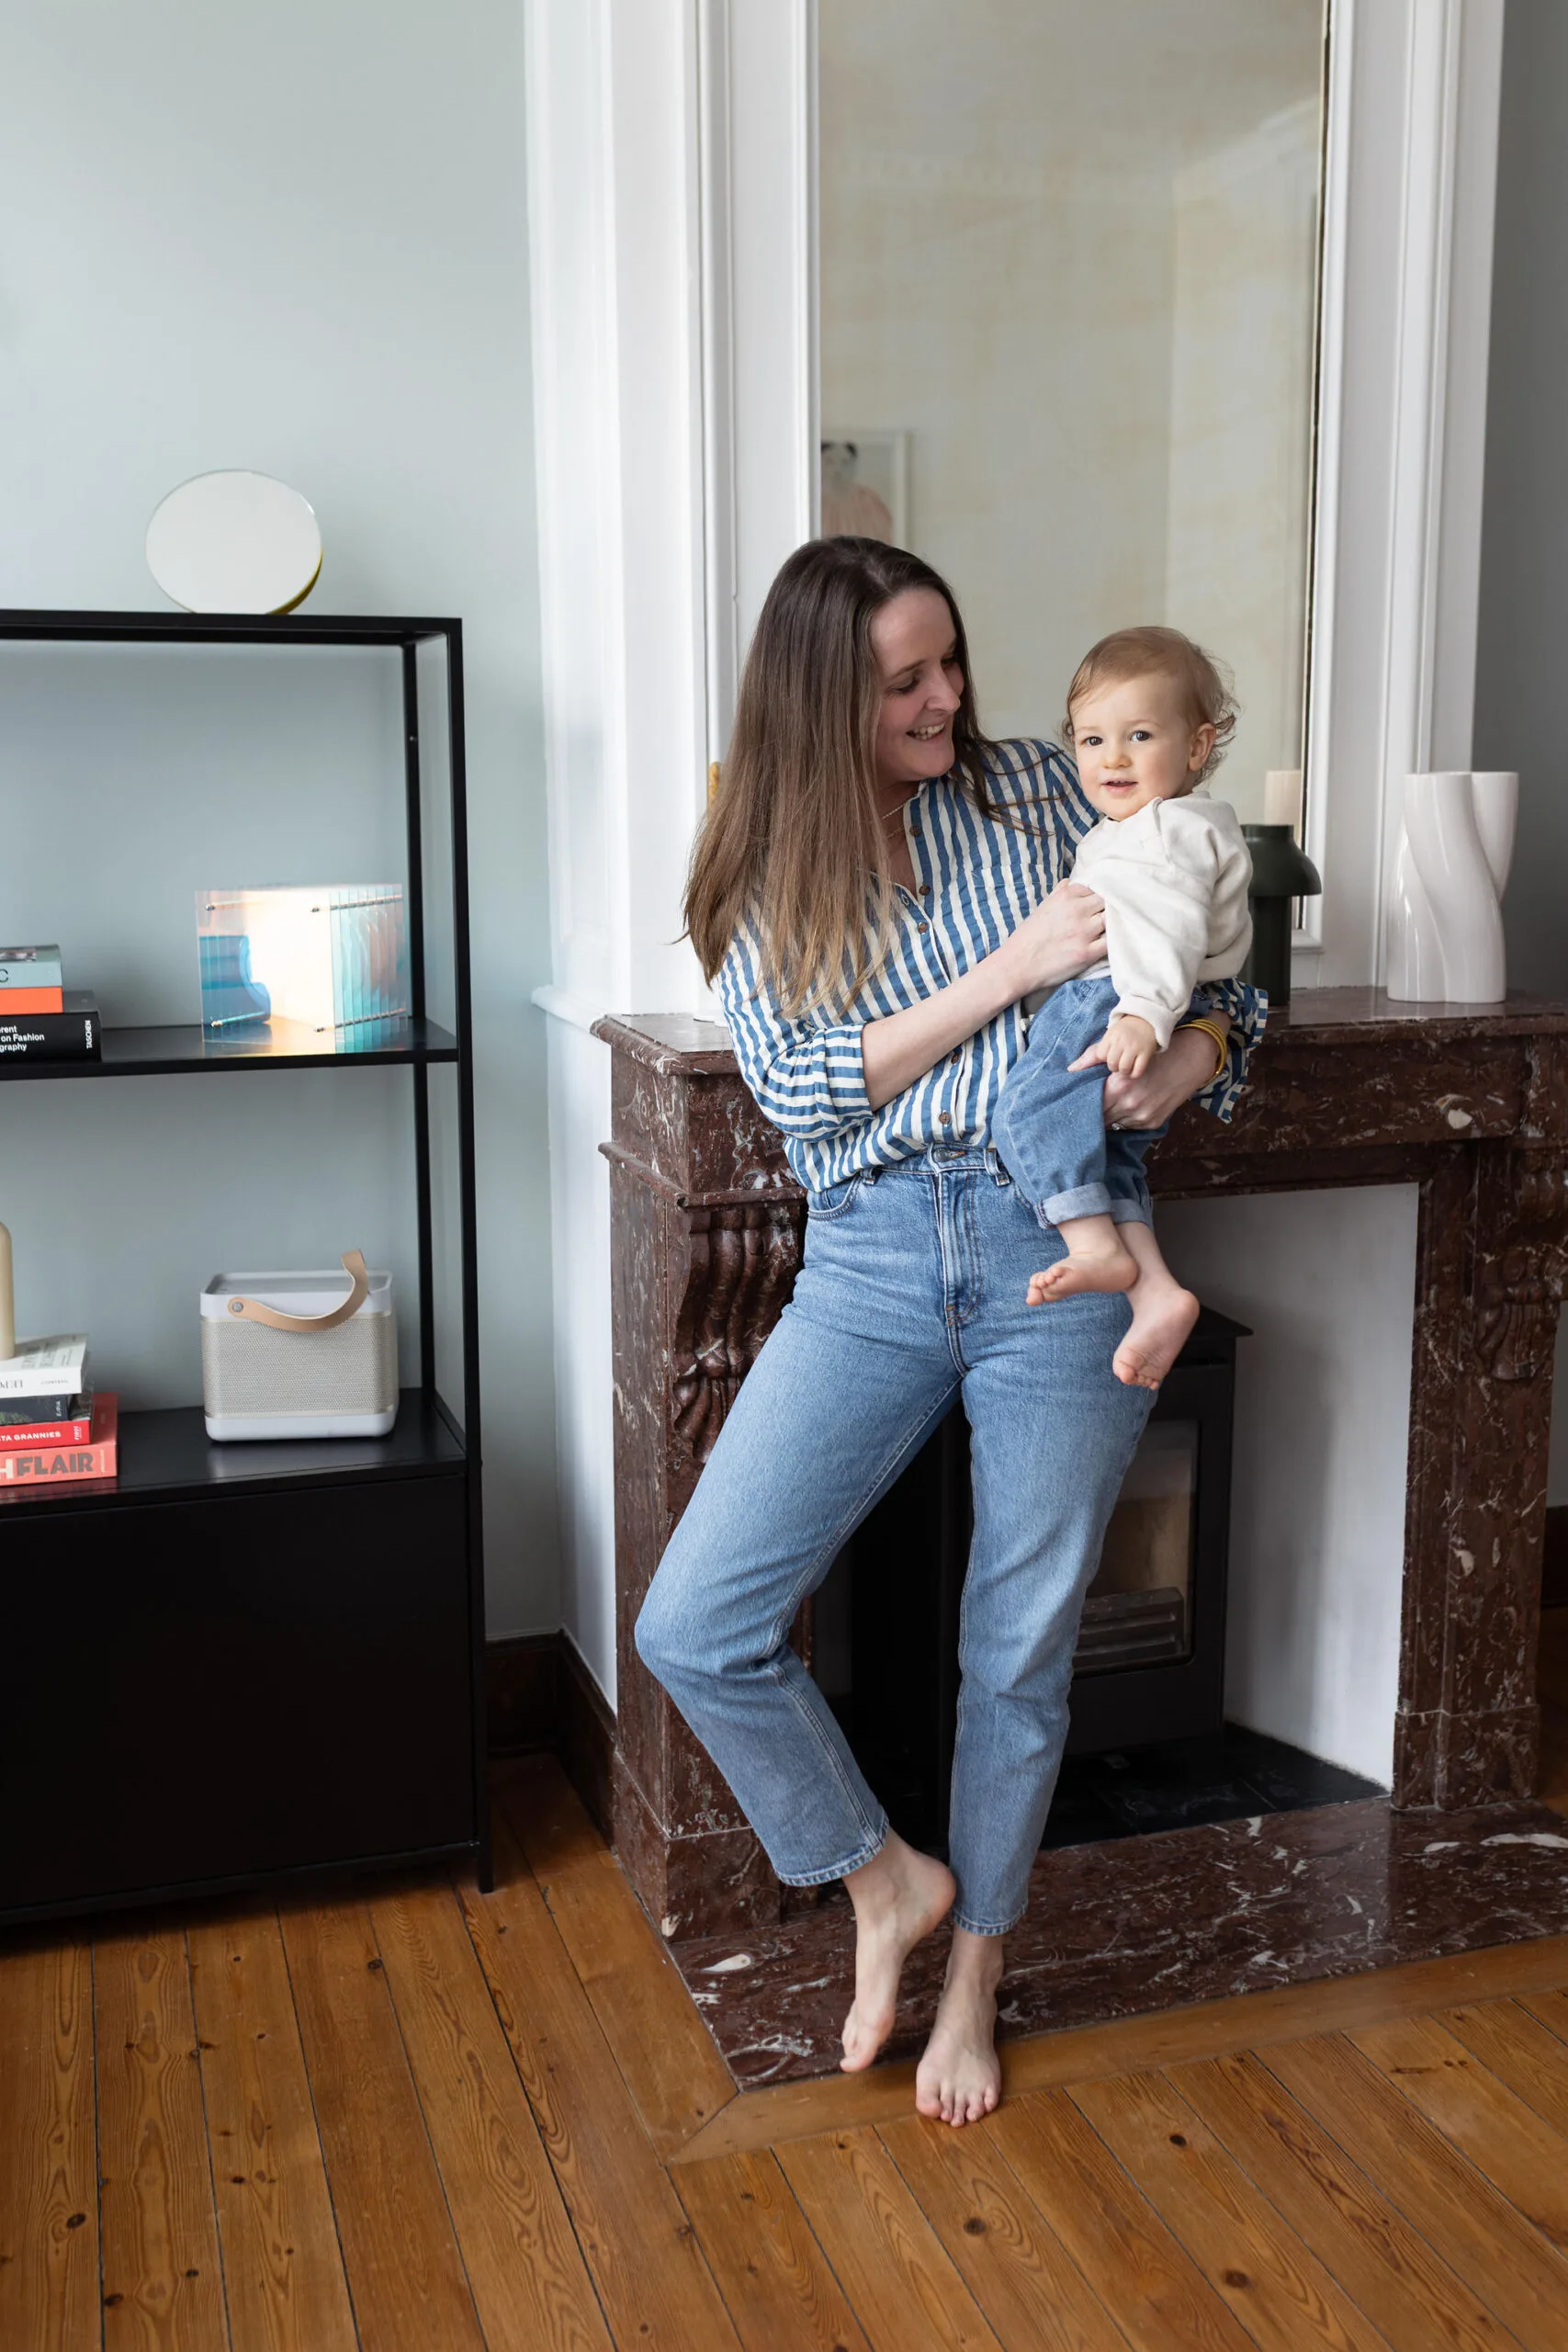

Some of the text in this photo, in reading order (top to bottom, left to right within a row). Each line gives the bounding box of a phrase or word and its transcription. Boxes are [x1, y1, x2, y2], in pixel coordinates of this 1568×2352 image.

[0, 1025, 17, 1034] rent
[1, 1033, 45, 1043] on Fashion
[14, 1430, 62, 1442] GRANNIES
[17, 1452, 95, 1477] FLAIR
